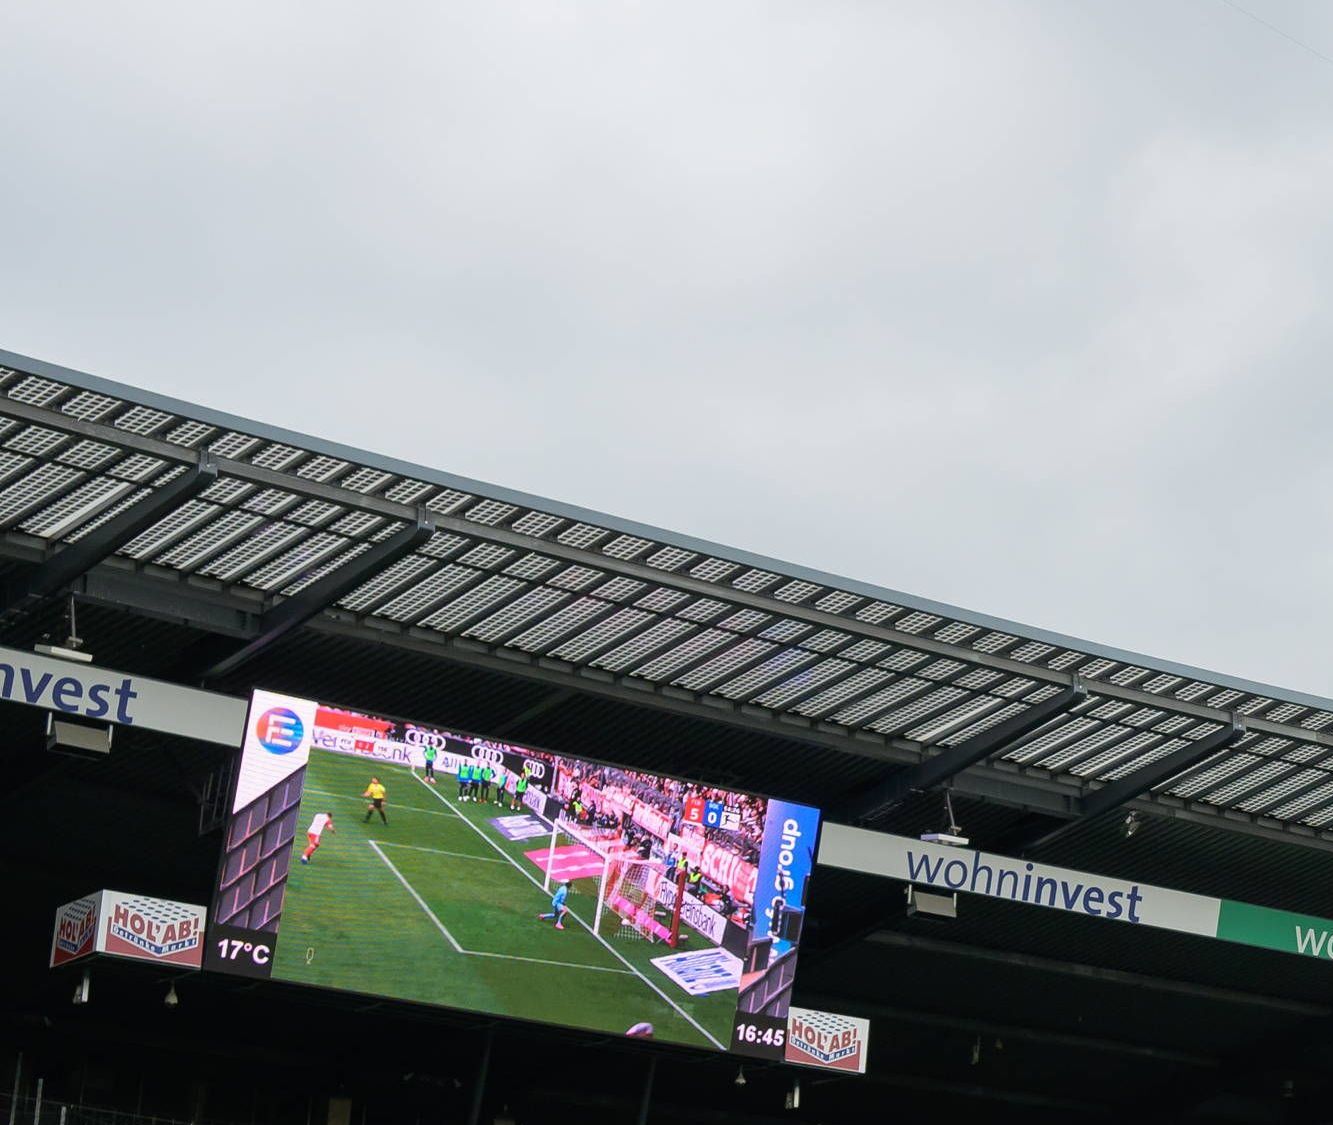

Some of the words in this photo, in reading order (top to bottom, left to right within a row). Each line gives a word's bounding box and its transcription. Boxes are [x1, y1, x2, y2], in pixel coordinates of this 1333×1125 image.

[907, 851, 1143, 923] wohninvest
[218, 938, 270, 965] 17°C
[736, 1023, 785, 1047] 16:45
